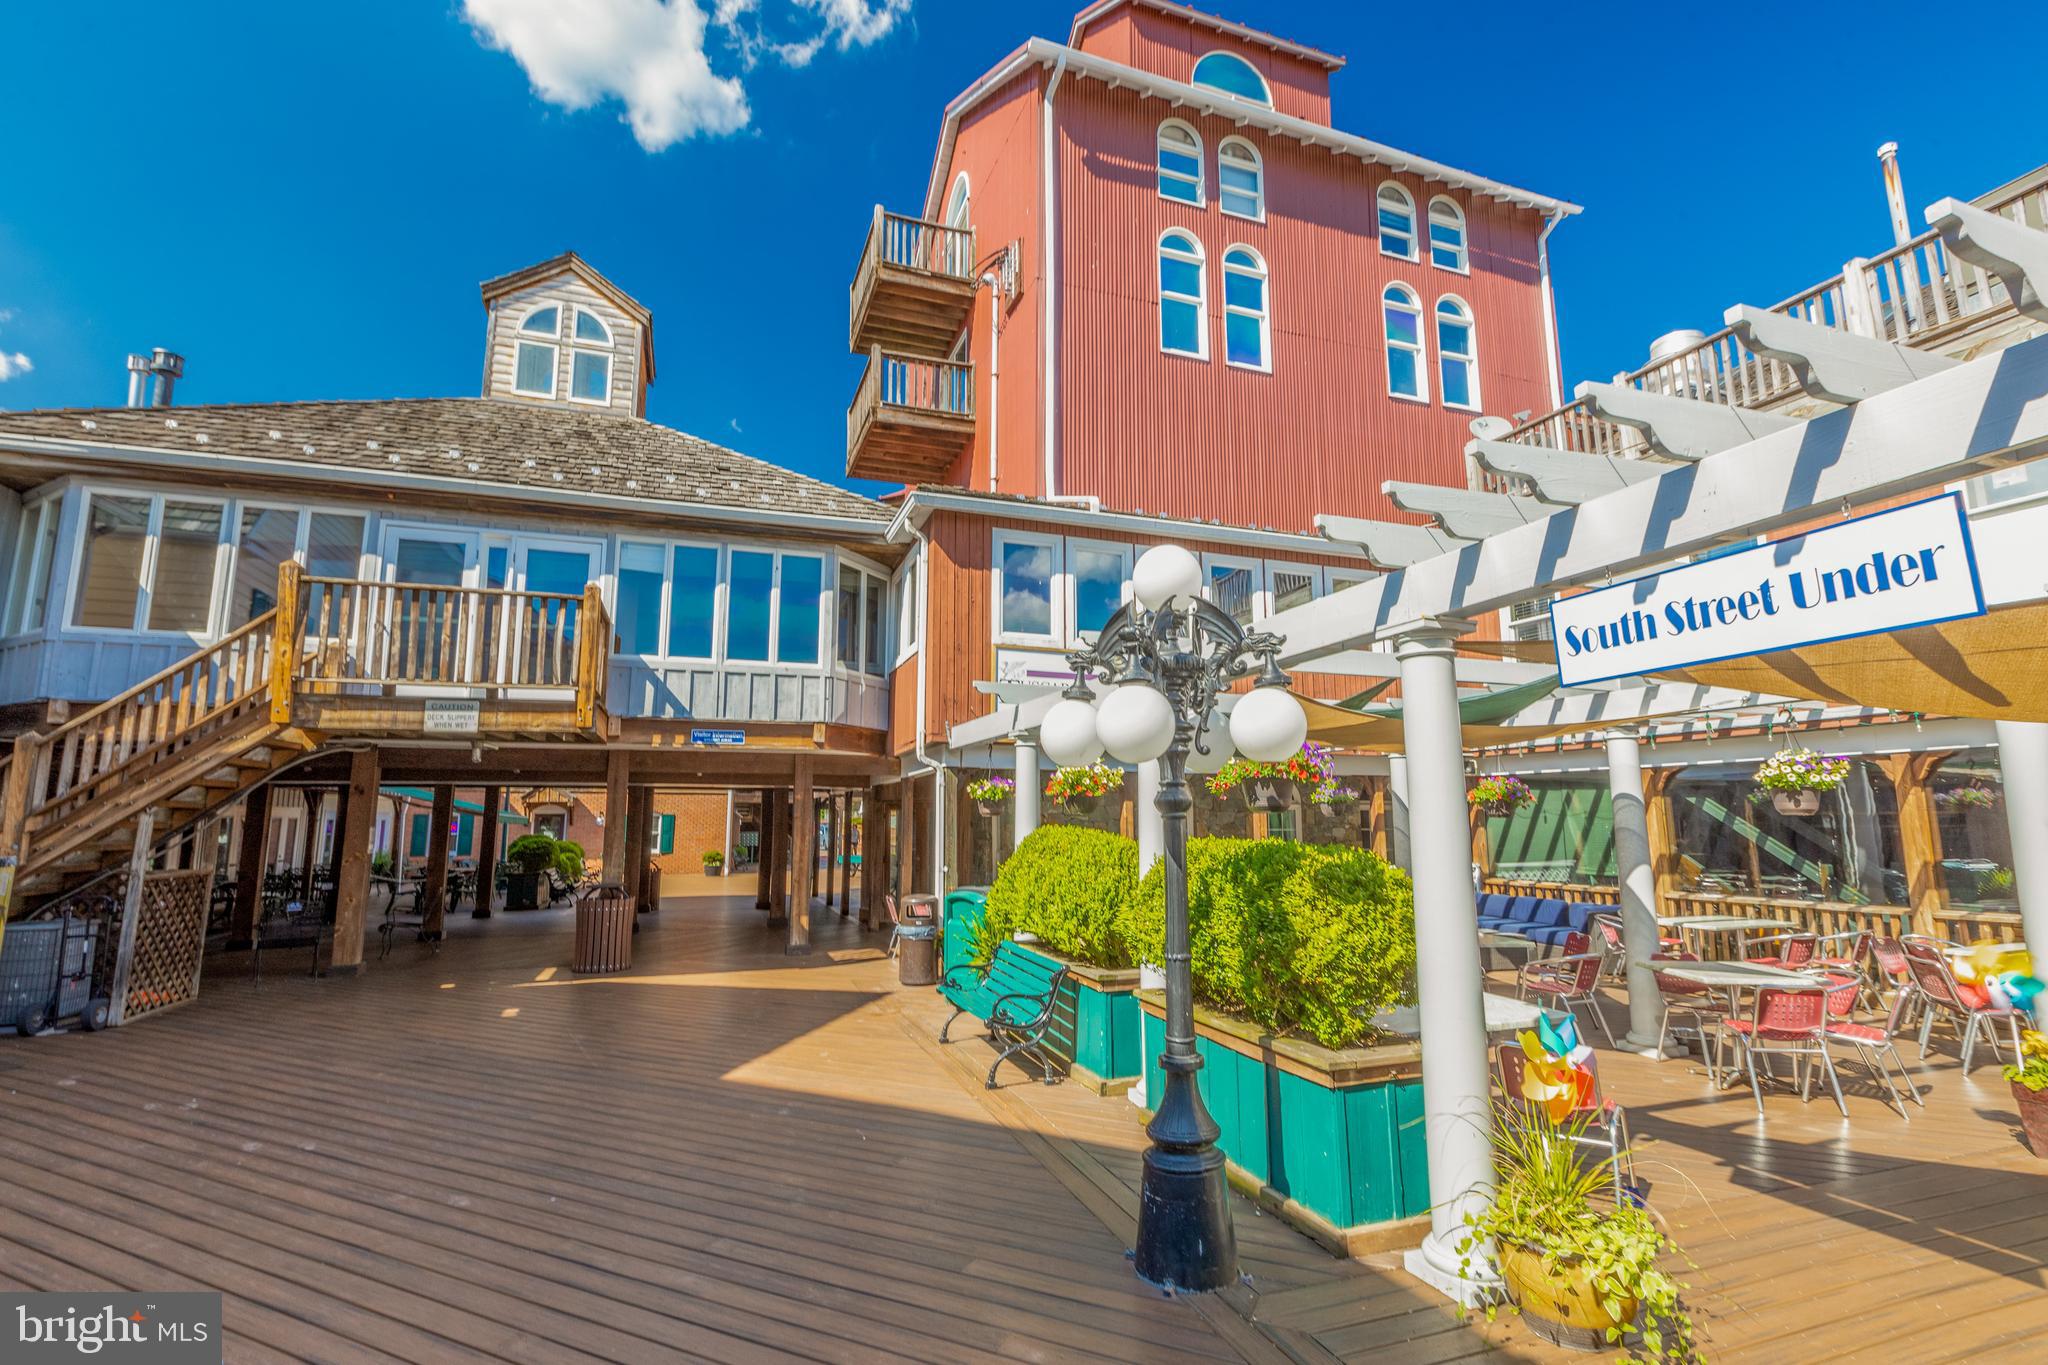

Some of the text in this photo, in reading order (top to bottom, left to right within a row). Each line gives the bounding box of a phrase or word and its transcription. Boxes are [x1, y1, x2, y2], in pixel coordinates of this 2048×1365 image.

[1565, 544, 1945, 657] South Street Under
[431, 703, 474, 711] CAUTION
[433, 721, 468, 729] WHEN WET
